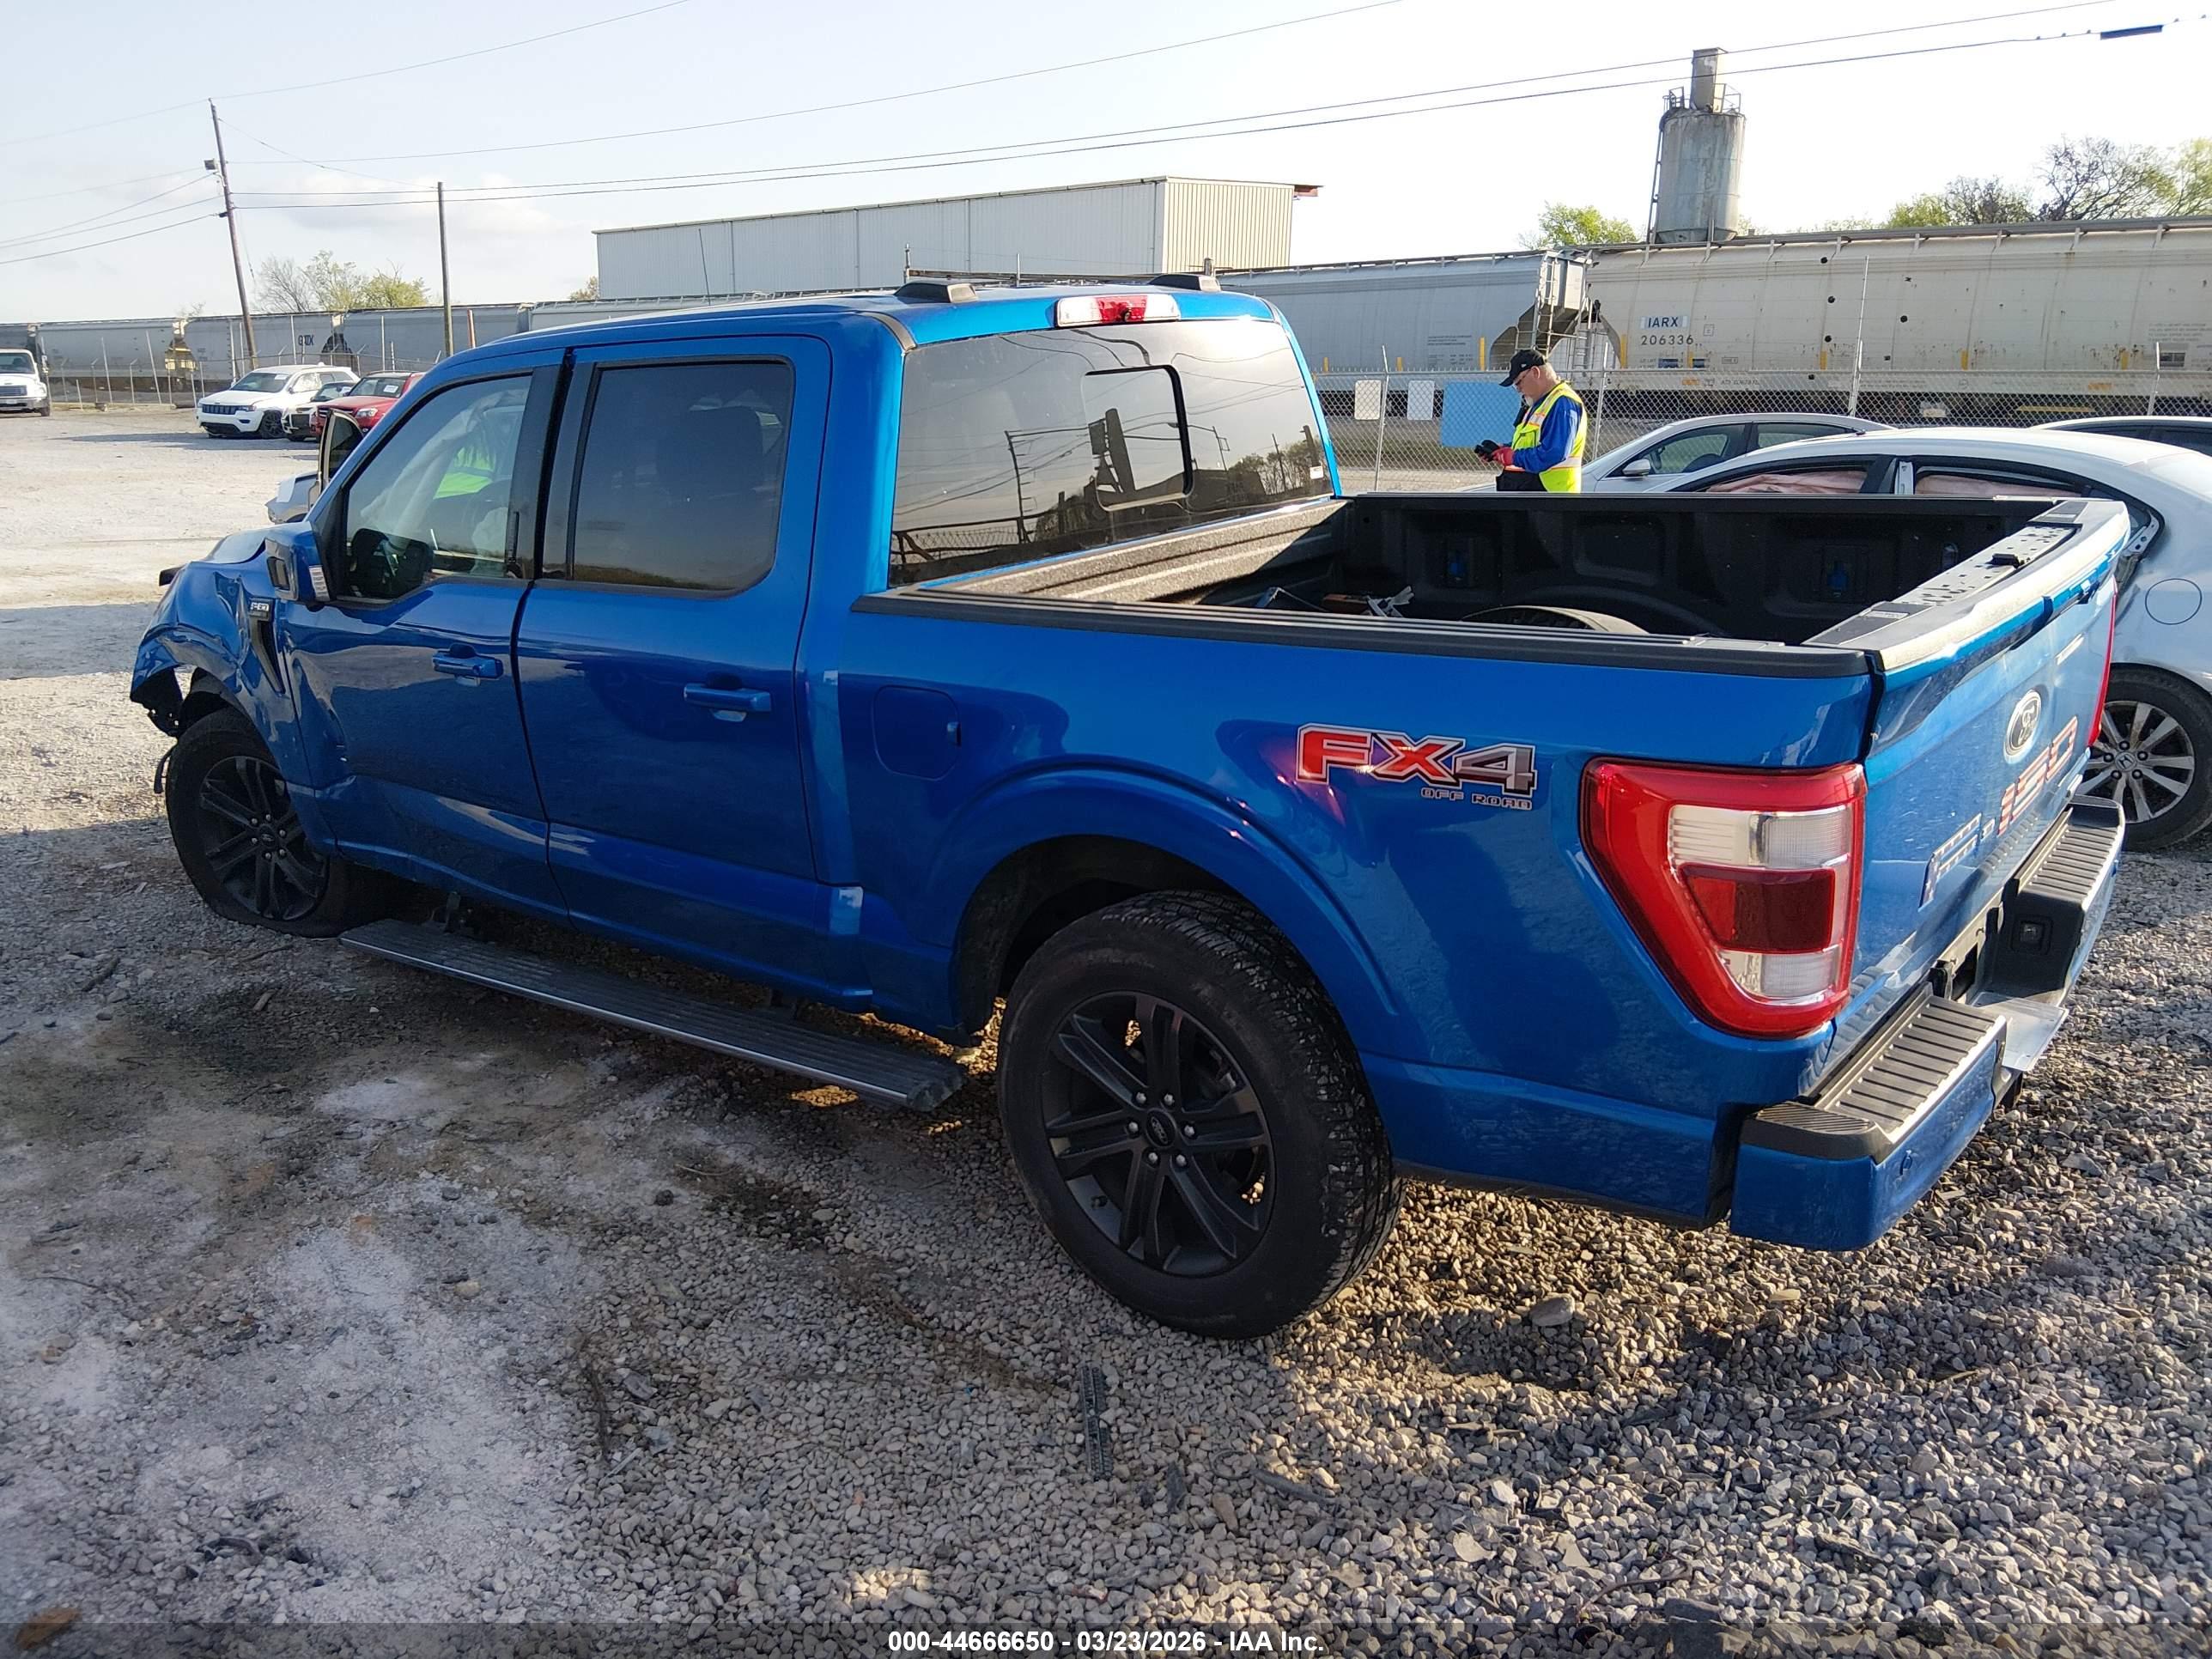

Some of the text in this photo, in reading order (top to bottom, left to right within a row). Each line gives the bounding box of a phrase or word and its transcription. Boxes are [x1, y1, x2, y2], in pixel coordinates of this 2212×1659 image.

[1647, 316, 1679, 328] IARX
[1641, 334, 1694, 346] 206336
[1296, 722, 1538, 797] FX4
[1419, 787, 1534, 811] OFF ROAD
[1917, 715, 2078, 912] F-150
